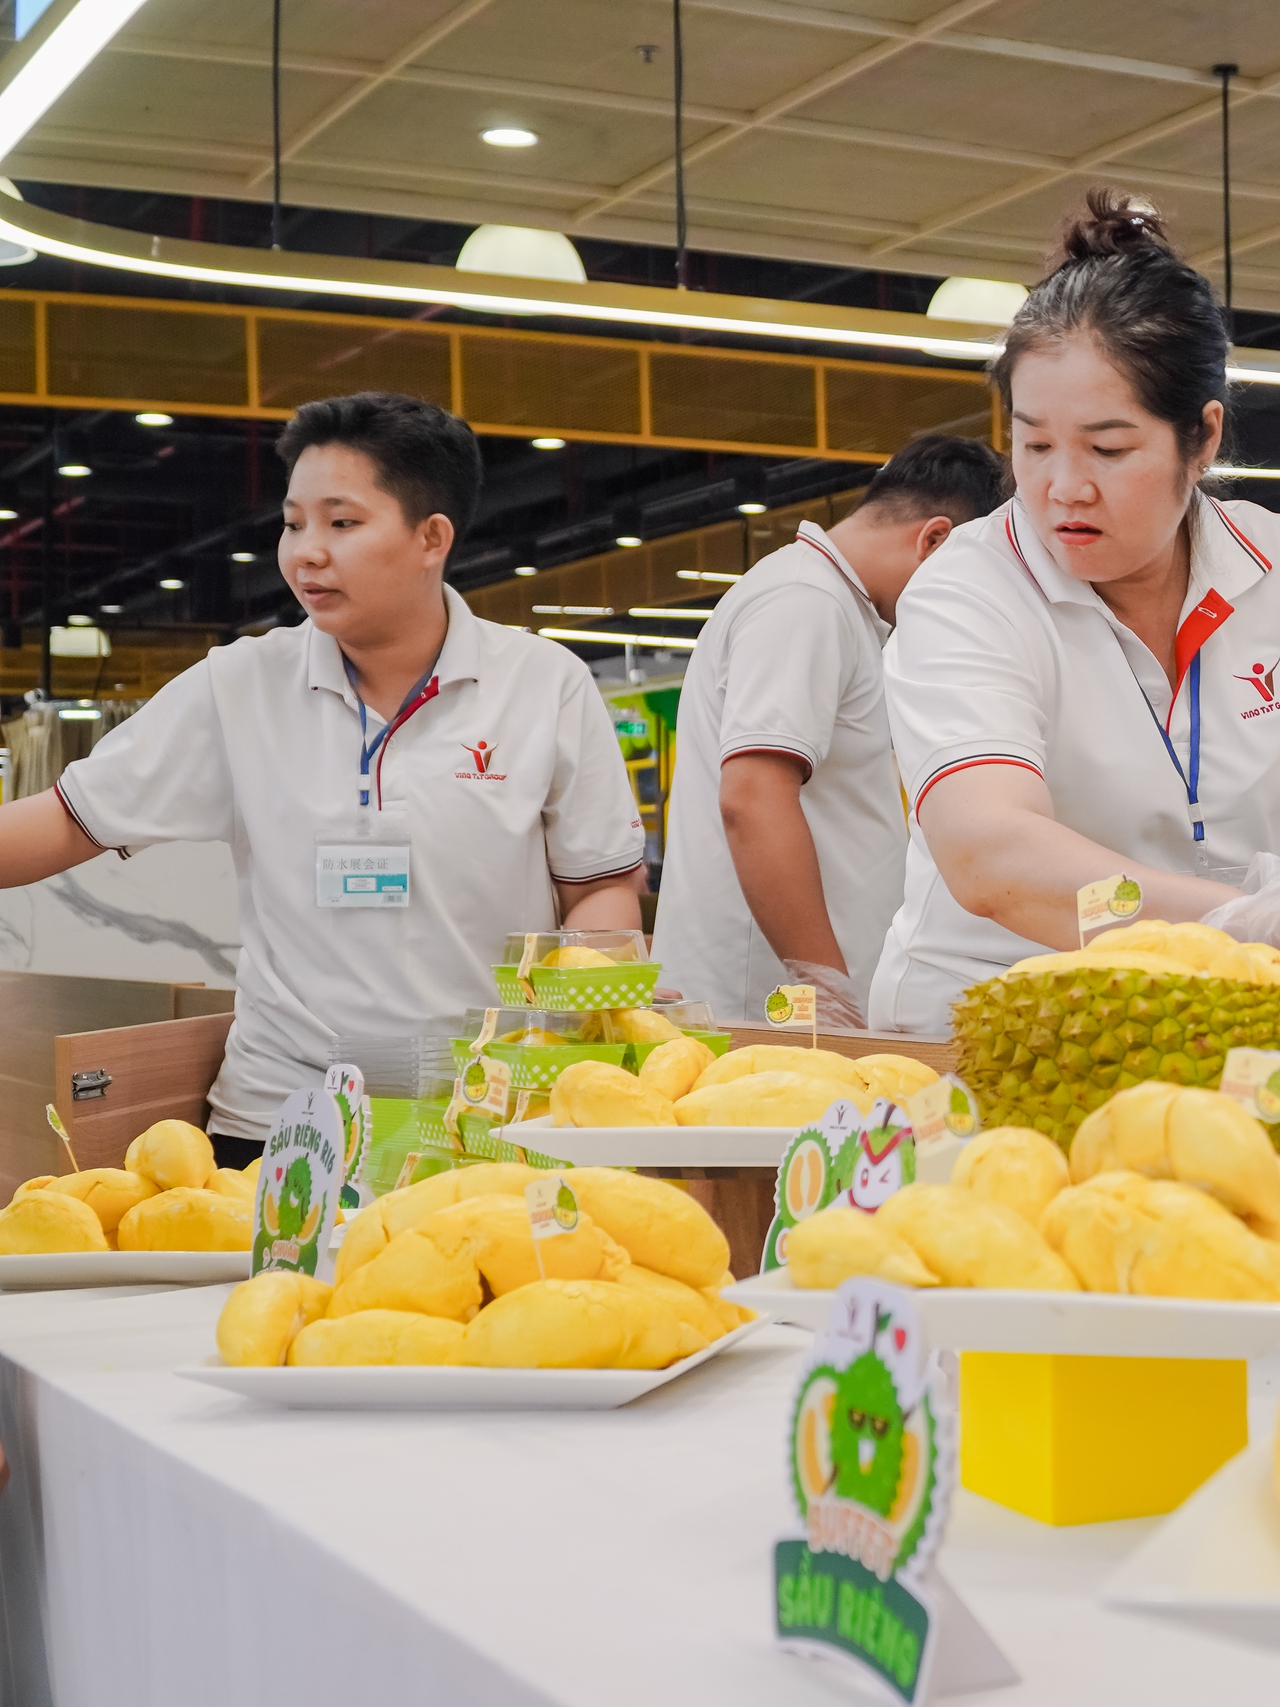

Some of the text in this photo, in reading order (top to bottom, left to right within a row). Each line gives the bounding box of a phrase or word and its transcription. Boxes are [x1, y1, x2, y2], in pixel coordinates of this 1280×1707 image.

[322, 858, 389, 870] 防水展会证
[270, 1119, 292, 1158] SẦU
[294, 1119, 321, 1154] RIÊNG
[271, 1235, 300, 1264] CHUẨN
[779, 1549, 919, 1687] SẦU RIÊNG
